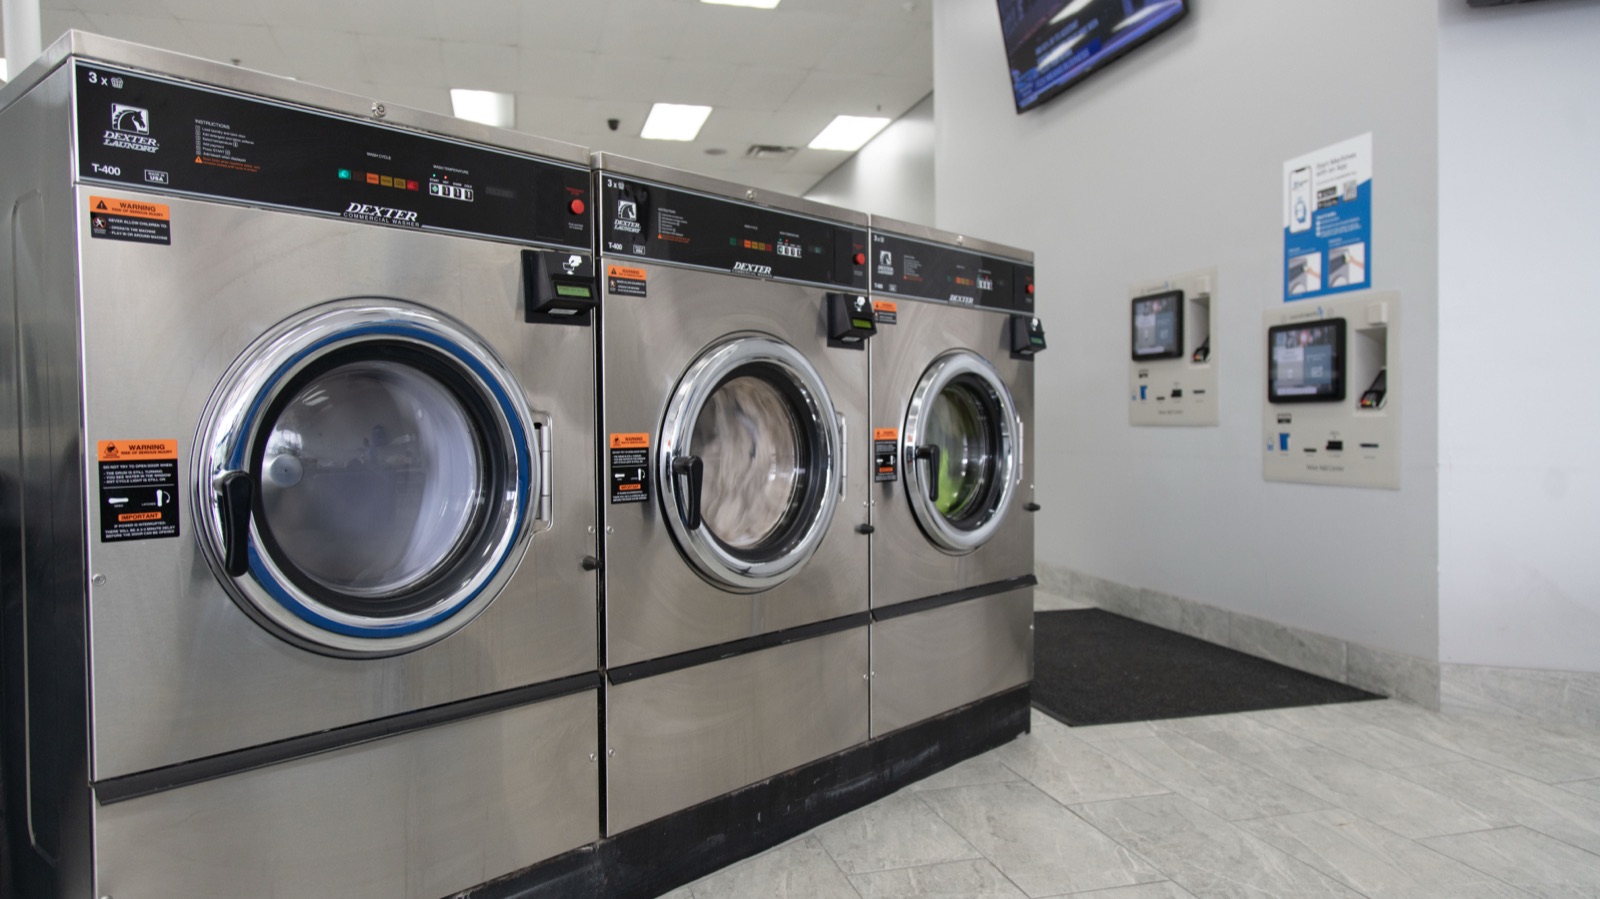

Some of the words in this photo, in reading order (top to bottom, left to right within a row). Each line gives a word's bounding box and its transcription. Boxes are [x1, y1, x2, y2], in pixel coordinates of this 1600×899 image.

[89, 72, 97, 84] 3
[101, 78, 108, 86] x
[195, 119, 230, 130] INSTRUCTIONS
[103, 131, 157, 147] DEXTER
[103, 139, 160, 153] LAUNDRY
[92, 163, 120, 176] T-400
[444, 166, 469, 175] TEMPERATURE
[608, 179, 612, 187] 3
[120, 203, 156, 212] WARNING
[346, 202, 418, 222] DEXTER
[343, 212, 389, 224] COMMERCIAL
[392, 219, 420, 228] WASHER
[614, 219, 640, 227] DEXTER
[614, 225, 641, 233] LAUNDRY
[608, 242, 622, 250] T-400
[733, 262, 772, 274] DEXTER
[950, 294, 974, 304] DEXTER
